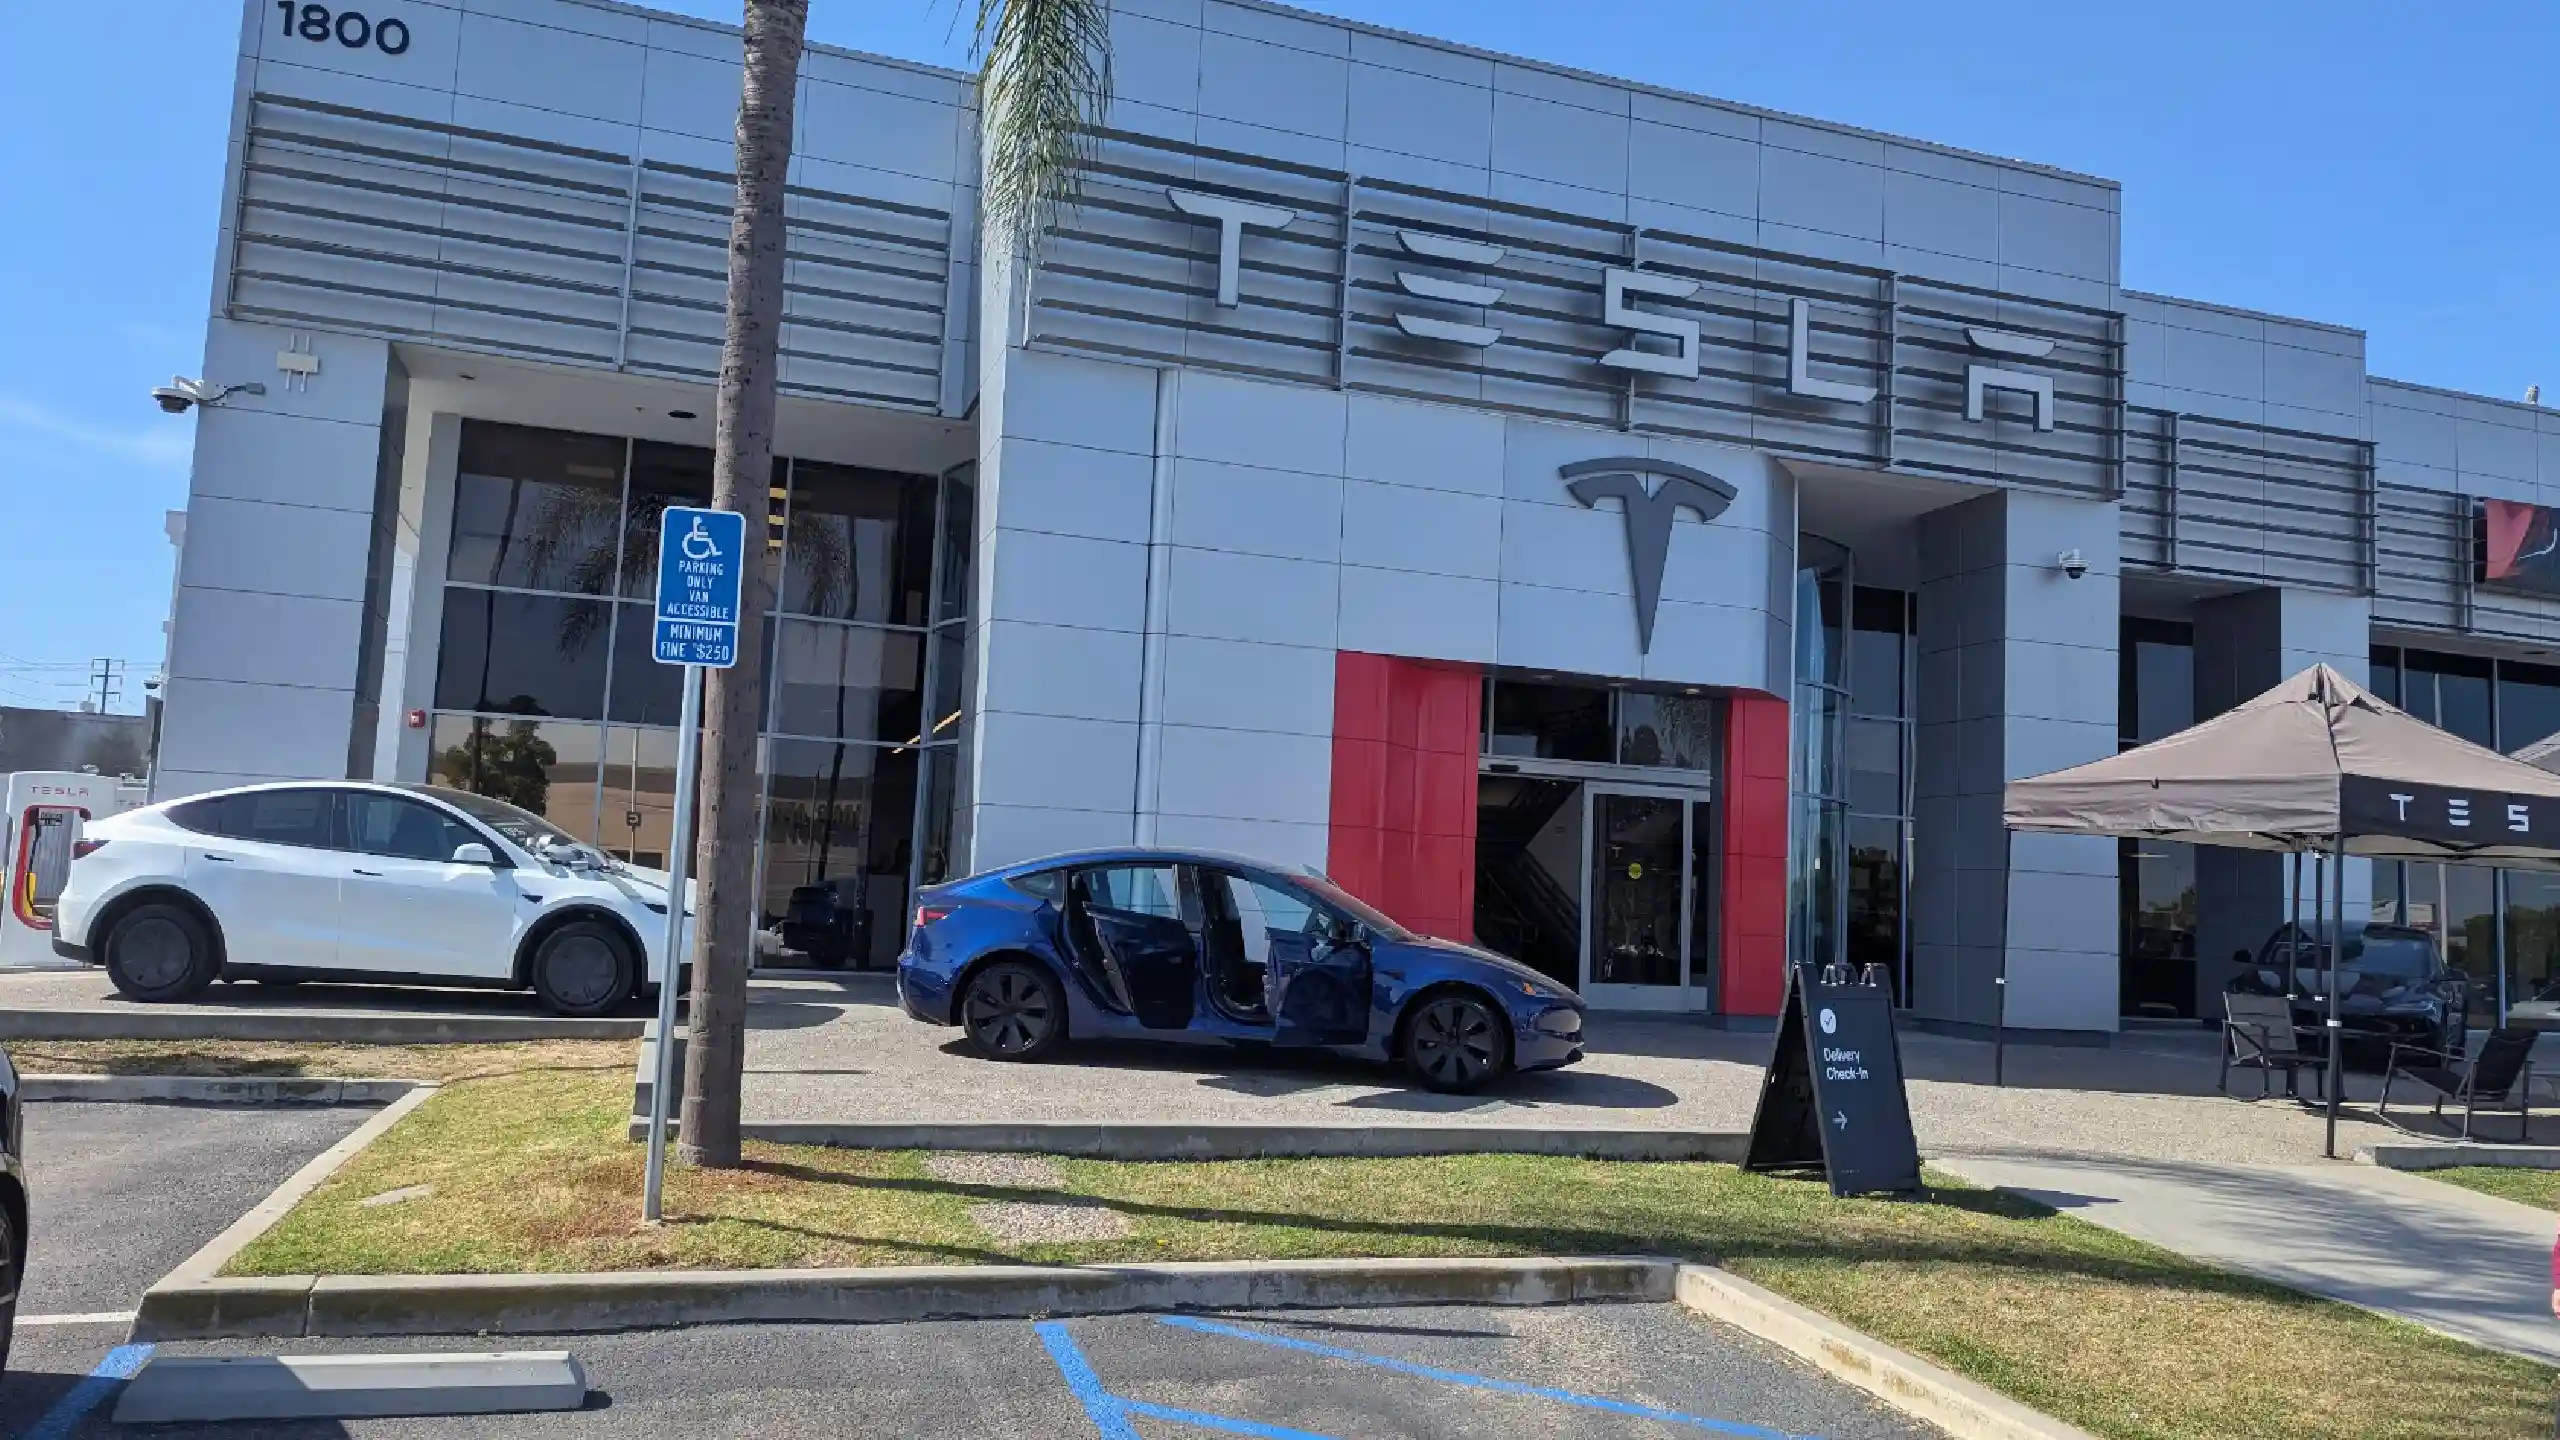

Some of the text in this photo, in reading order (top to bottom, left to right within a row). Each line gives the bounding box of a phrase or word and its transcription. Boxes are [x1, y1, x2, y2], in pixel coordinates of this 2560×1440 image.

[277, 0, 410, 55] 1800
[1165, 188, 2058, 433] TESLA
[678, 560, 724, 576] PARKING
[686, 575, 715, 590] ONLY
[689, 589, 709, 603] VAN
[666, 602, 729, 619] ACCESSIBLE
[670, 623, 723, 642] MINIMUM
[660, 641, 730, 661] FINE $250
[30, 786, 89, 797] TESLA
[1823, 1047, 1860, 1065] Delivery
